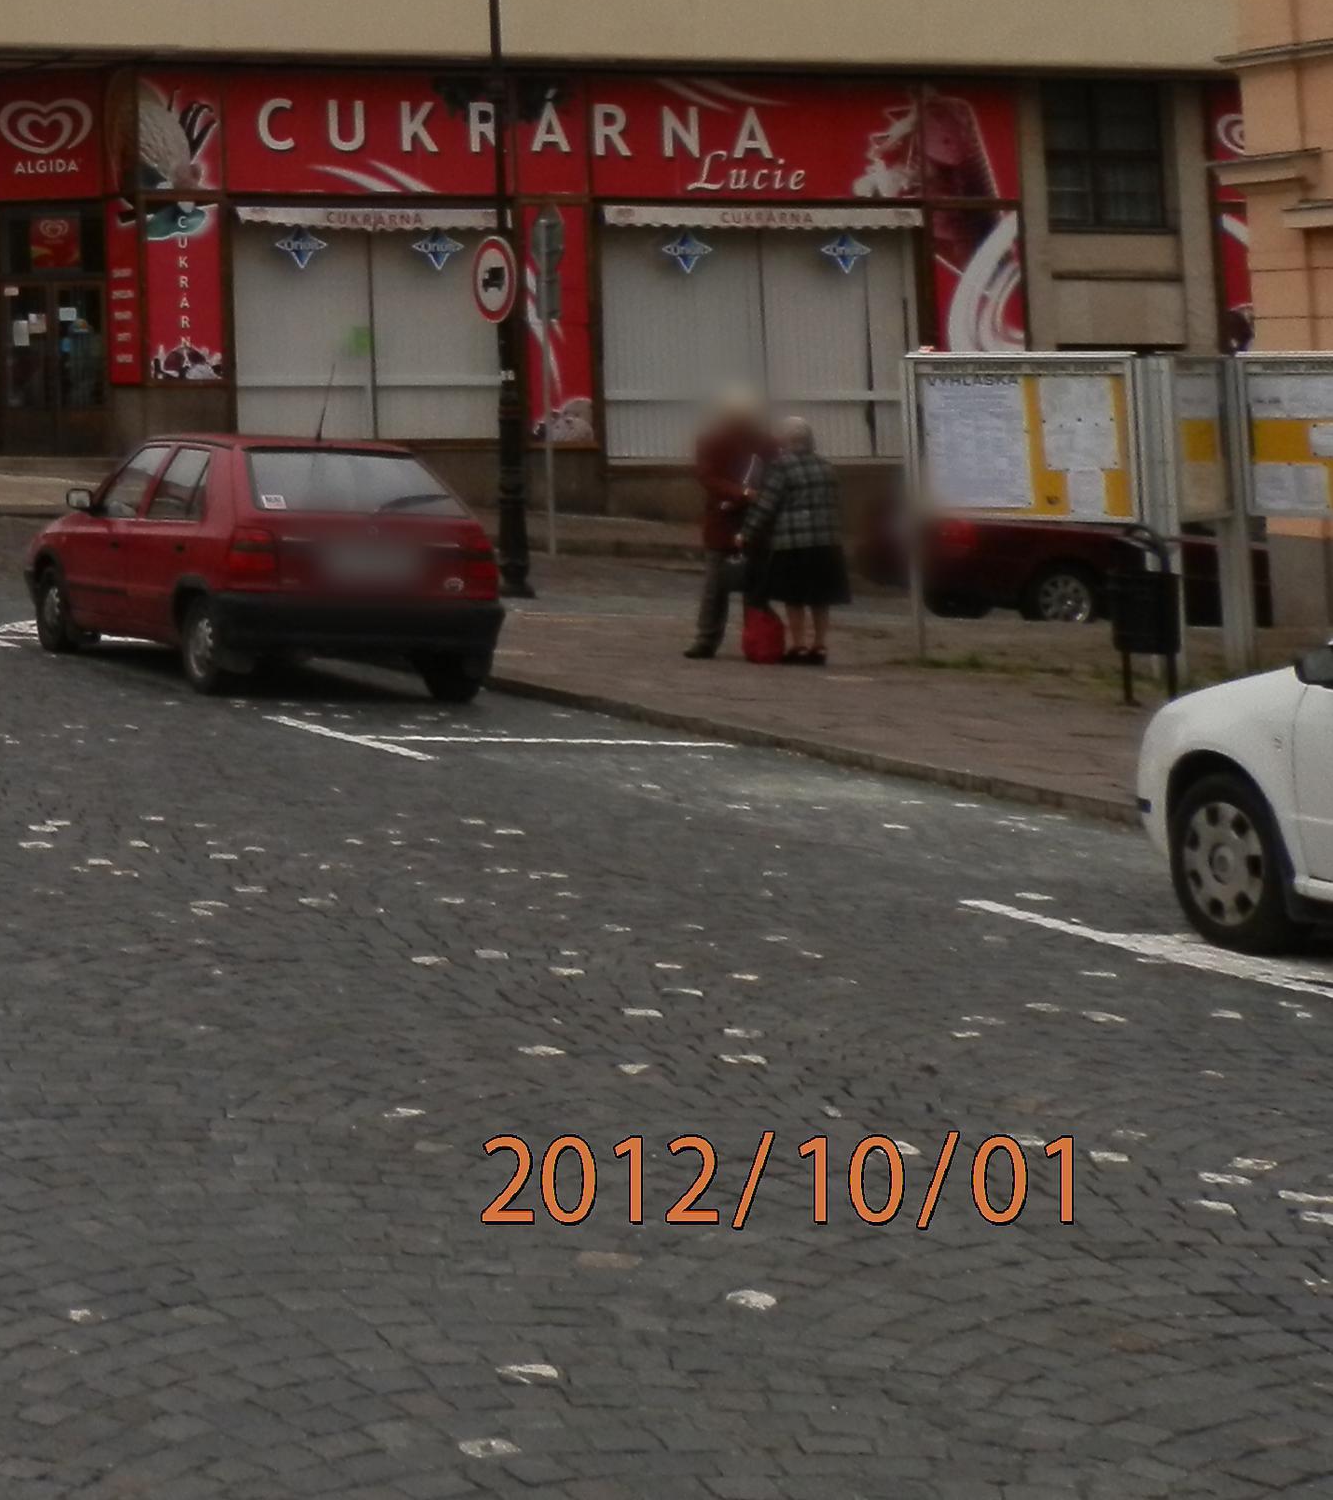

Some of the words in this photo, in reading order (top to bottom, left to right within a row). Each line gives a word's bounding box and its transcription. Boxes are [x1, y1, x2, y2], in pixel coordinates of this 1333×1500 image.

[257, 88, 774, 160] CUKRÁRNA
[14, 159, 78, 174] ALGIDA
[687, 150, 806, 191] Lucie
